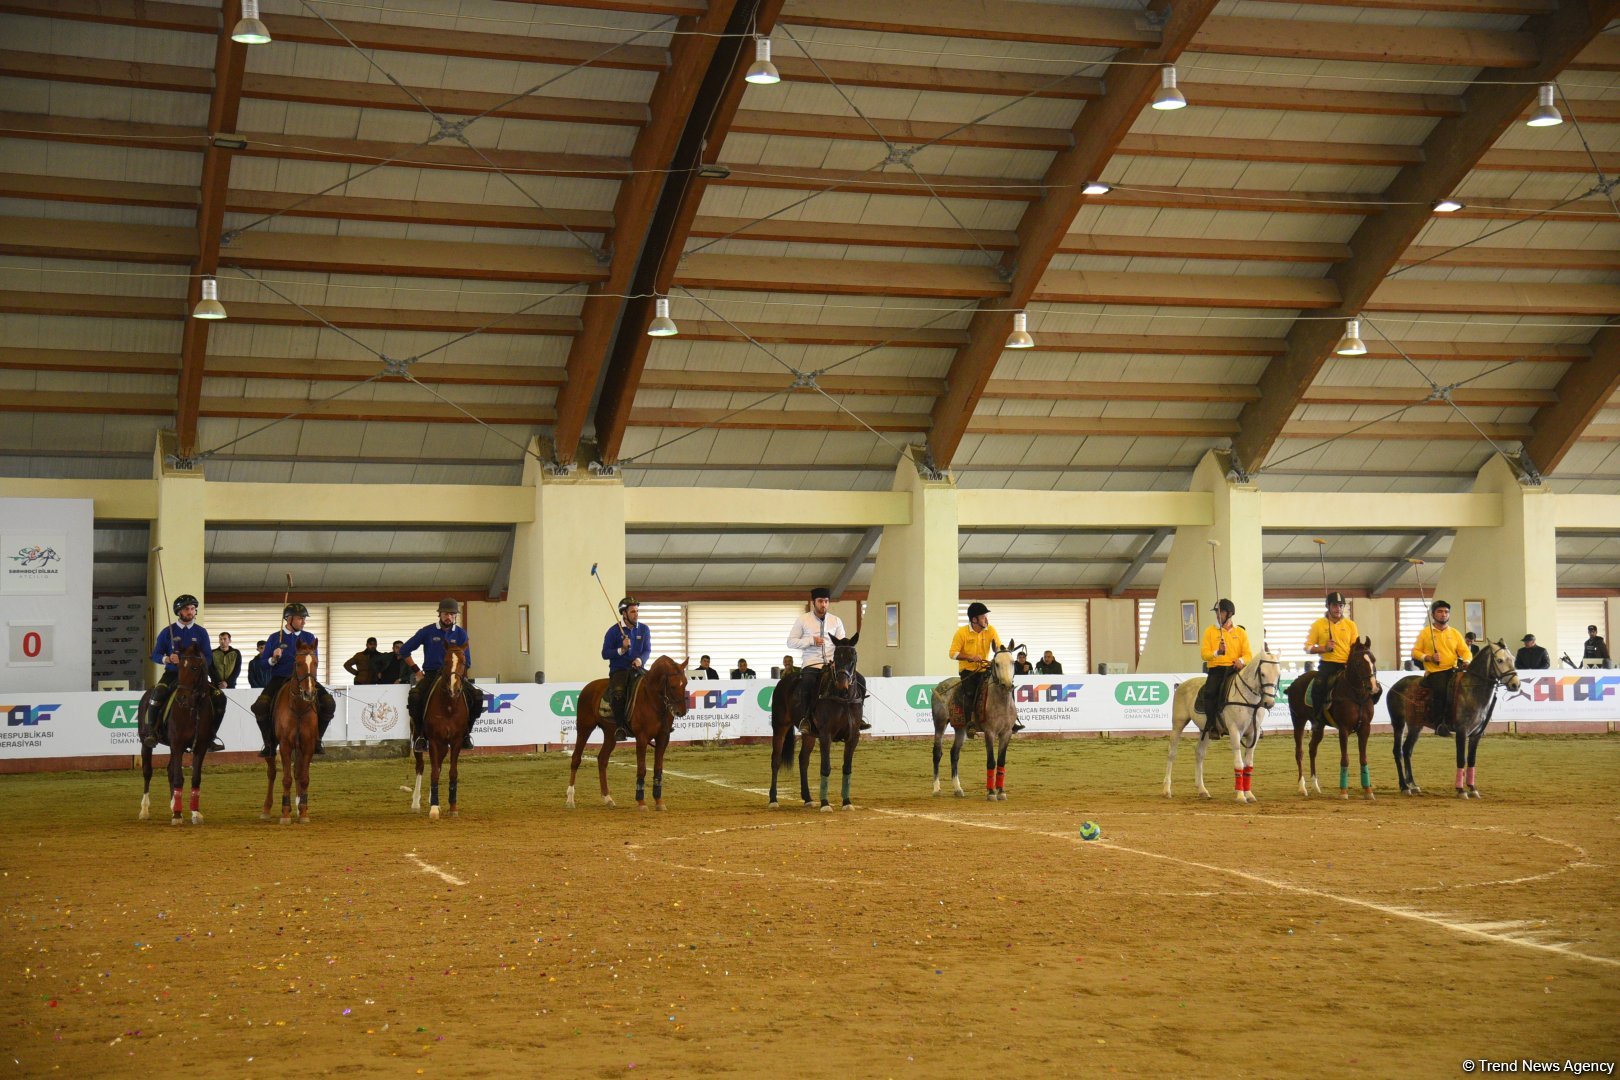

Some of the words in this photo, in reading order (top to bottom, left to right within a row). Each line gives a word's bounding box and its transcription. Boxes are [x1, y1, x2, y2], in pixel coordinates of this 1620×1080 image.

[23, 631, 42, 658] 0
[1124, 685, 1160, 702] AZE
[474, 717, 514, 725] SPUBLİKASI
[687, 720, 731, 728] FEDERASİYASI
[0, 740, 42, 748] ERASİYASI
